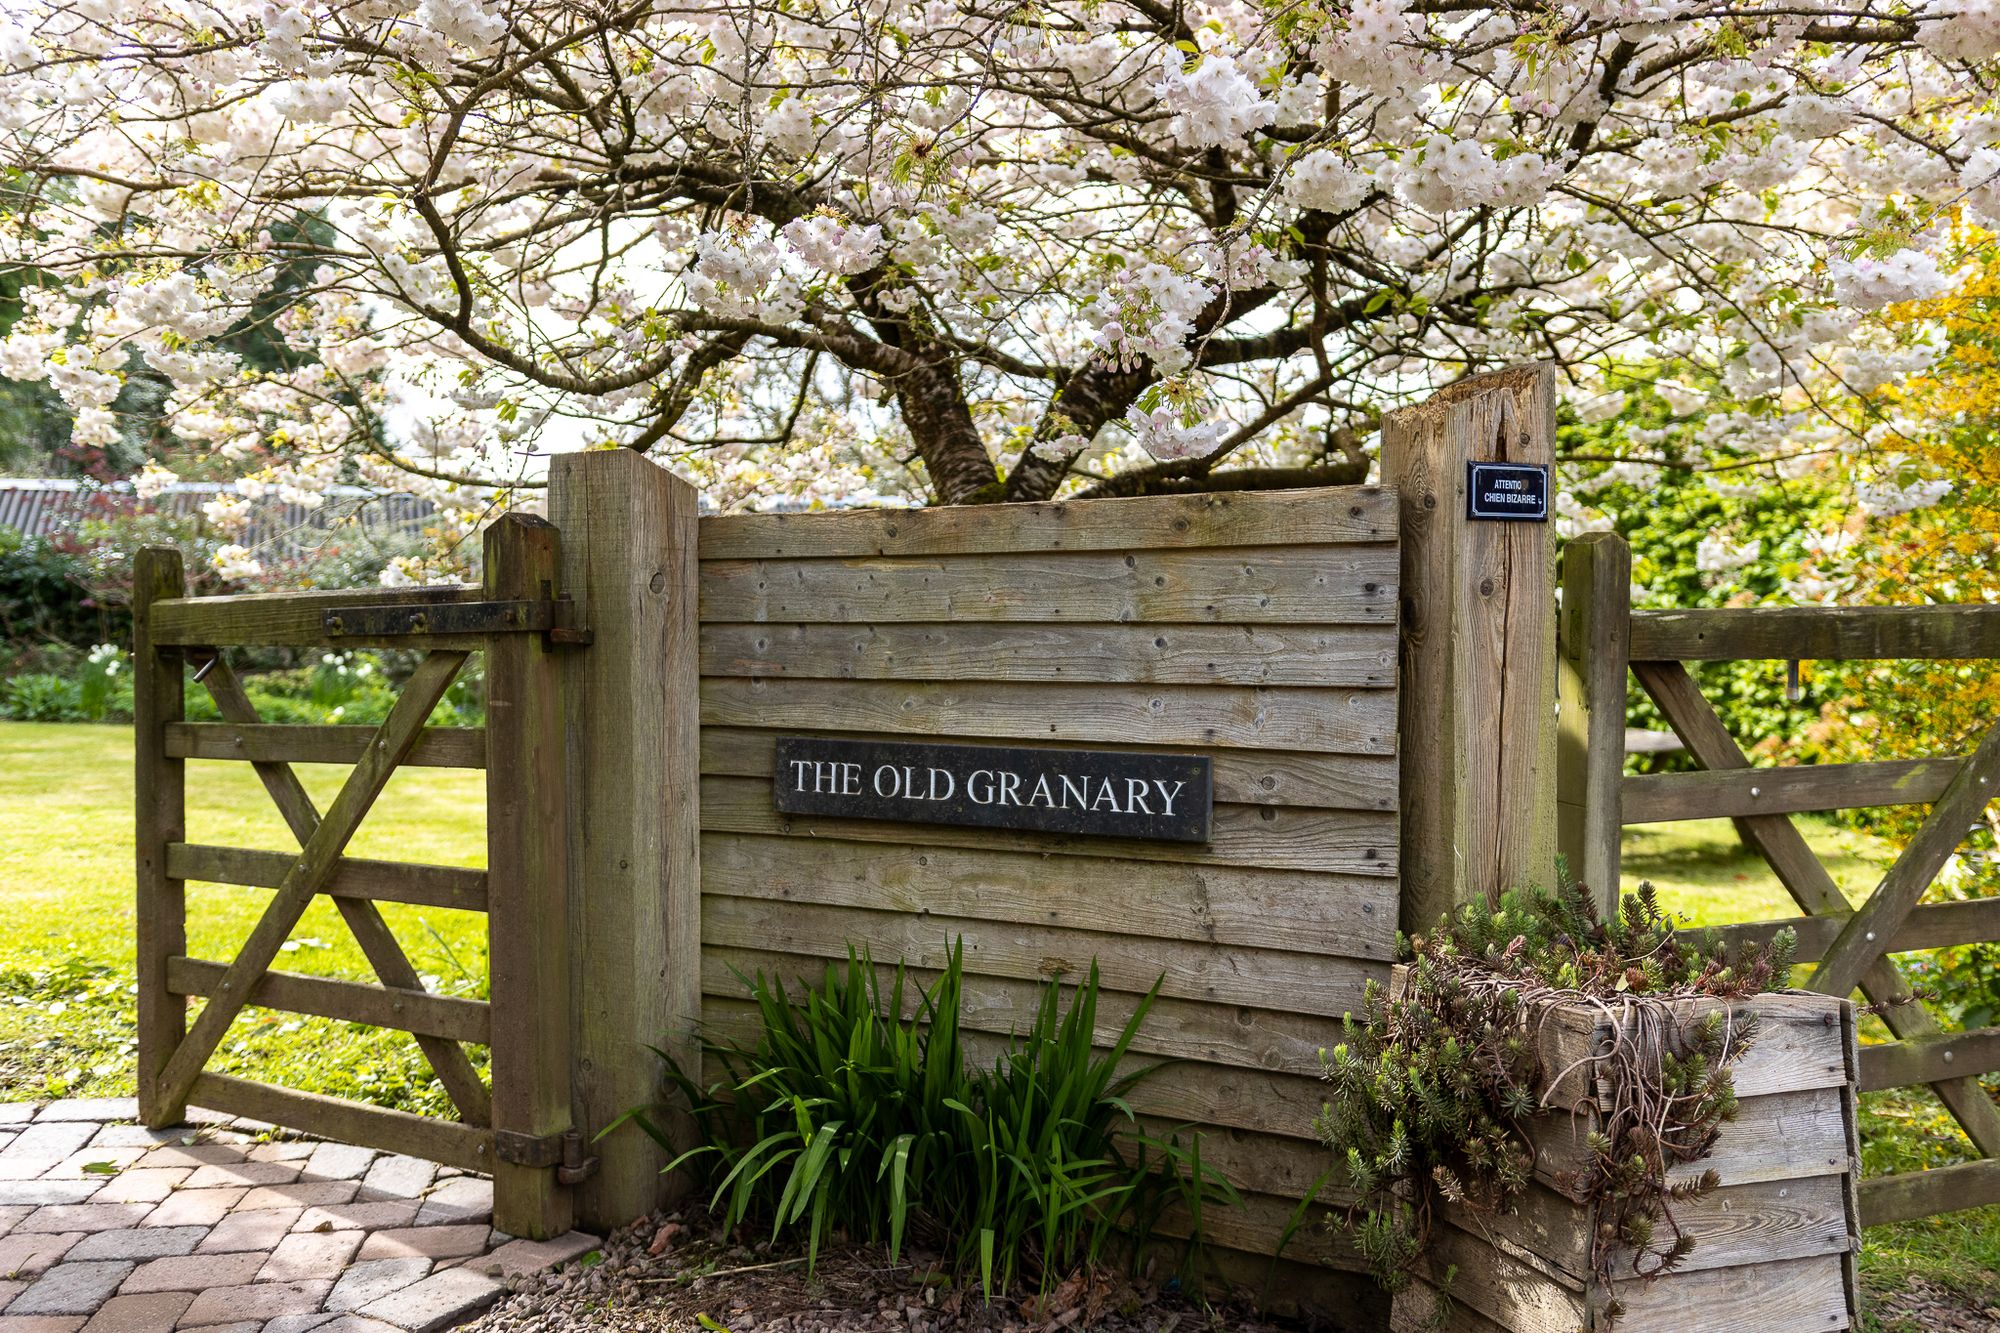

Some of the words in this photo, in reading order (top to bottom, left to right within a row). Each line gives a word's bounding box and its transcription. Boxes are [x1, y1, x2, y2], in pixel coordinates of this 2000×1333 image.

[1494, 479, 1523, 490] ATTENTIO
[1484, 492, 1506, 503] CHIEN
[1506, 493, 1536, 504] BIZARRE
[790, 759, 862, 795] THE
[872, 764, 955, 800] OLD
[966, 769, 1186, 816] GRANARY
